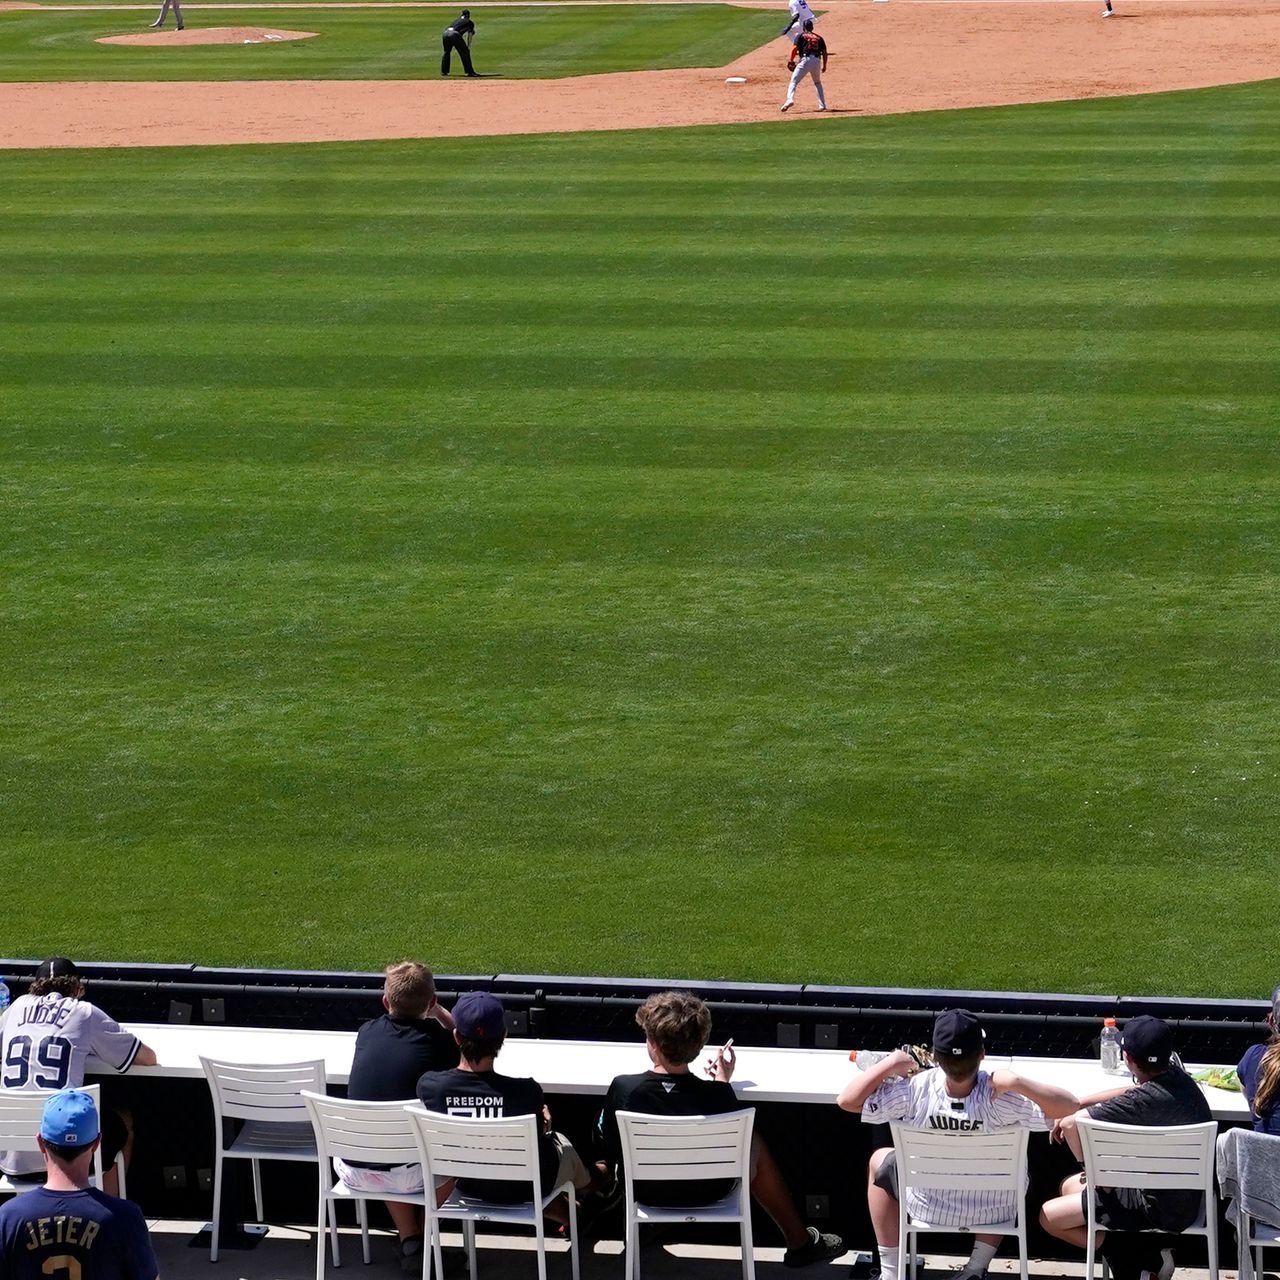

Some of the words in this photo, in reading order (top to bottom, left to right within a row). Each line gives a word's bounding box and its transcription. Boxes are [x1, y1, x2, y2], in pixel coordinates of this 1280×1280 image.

[4, 1035, 72, 1090] 99
[446, 1096, 504, 1106] FREEDOM
[26, 1216, 100, 1250] JETER
